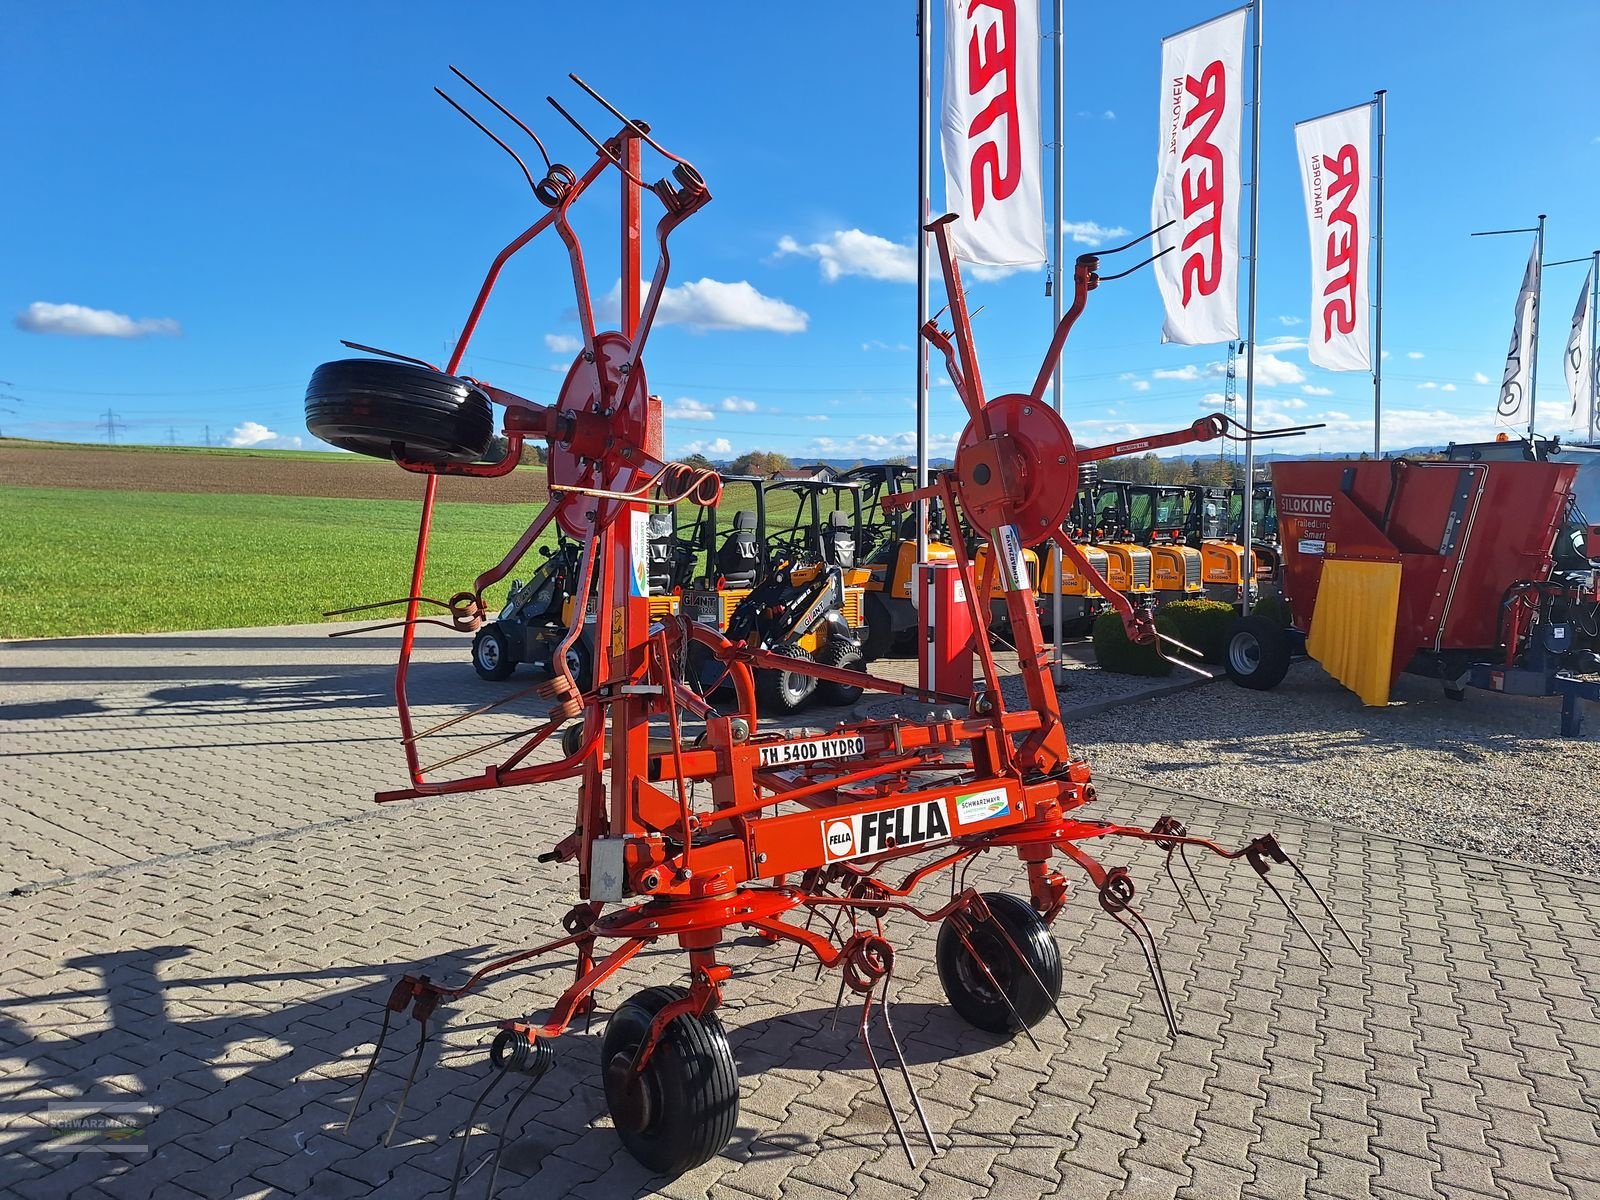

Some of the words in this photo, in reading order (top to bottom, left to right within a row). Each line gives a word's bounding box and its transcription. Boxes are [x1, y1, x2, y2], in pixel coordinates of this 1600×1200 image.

[1281, 499, 1332, 513] SILOKING
[1304, 530, 1325, 539] Smart
[1005, 534, 1019, 584] SCHWARZMAYR
[761, 748, 779, 764] TH
[822, 738, 864, 757] HYDRO
[962, 796, 1001, 808] SCHWARZMAYR
[860, 801, 949, 853] FELLA
[829, 832, 852, 845] FELLA
